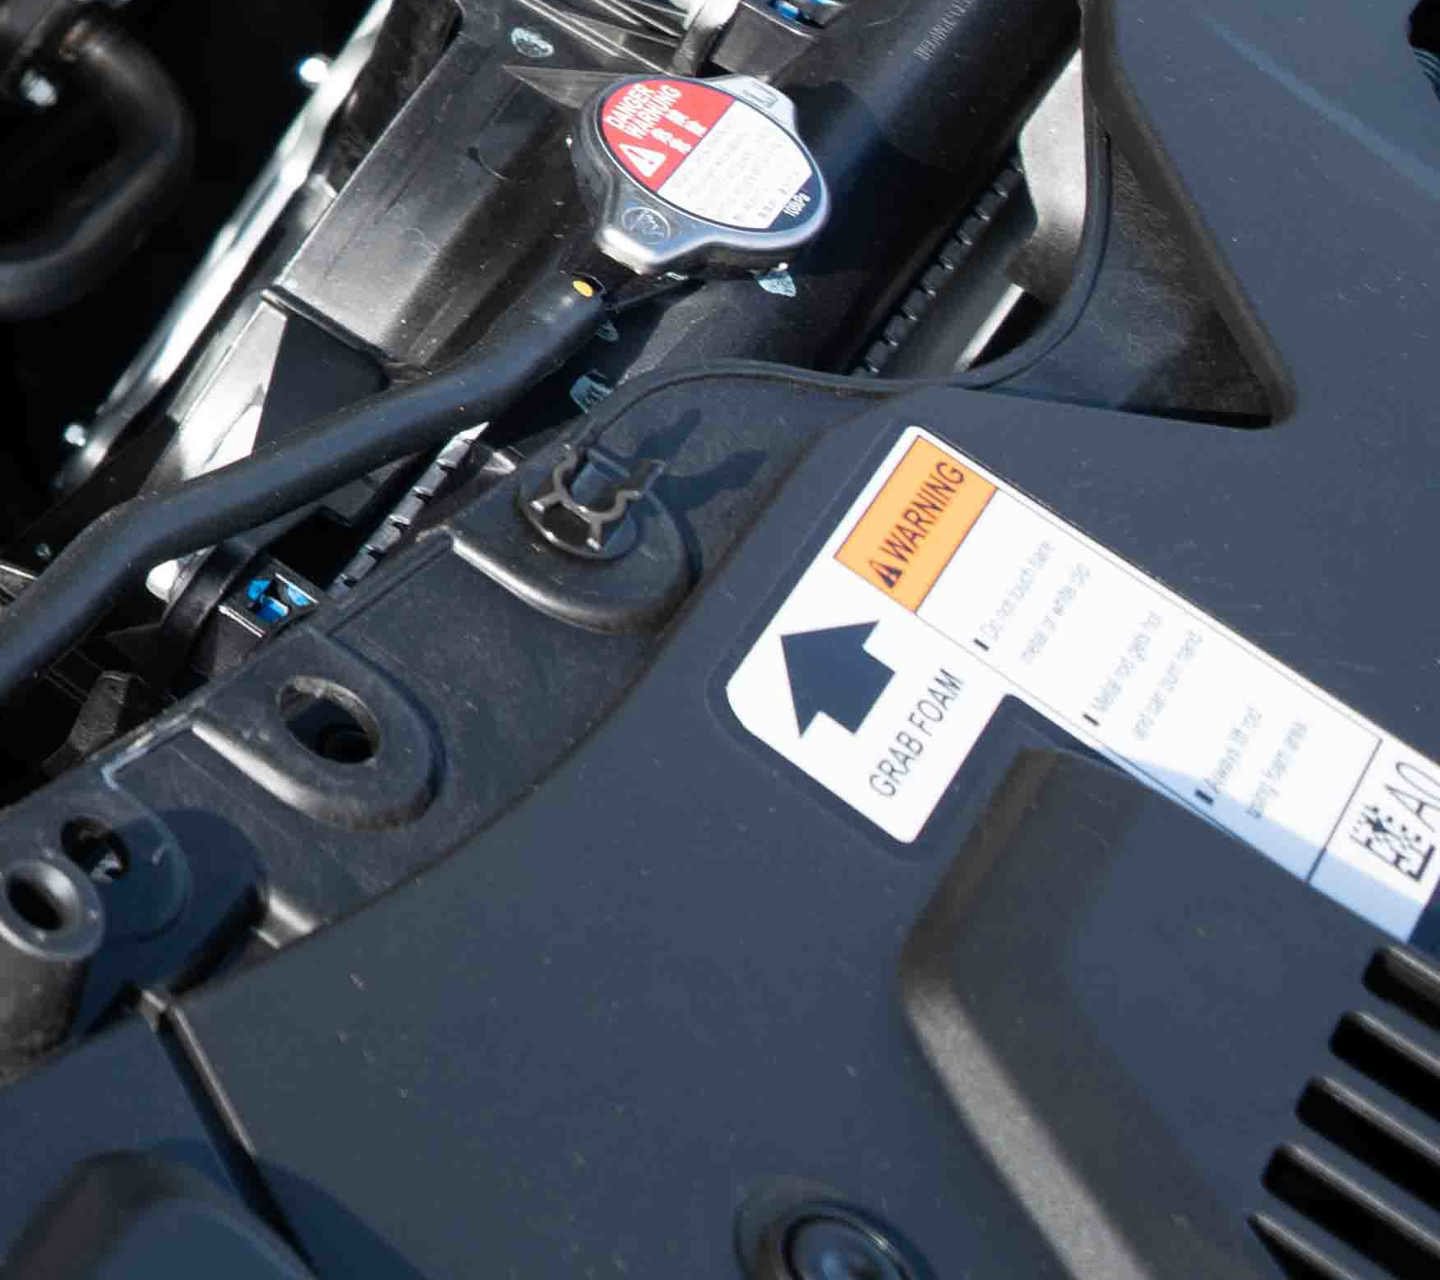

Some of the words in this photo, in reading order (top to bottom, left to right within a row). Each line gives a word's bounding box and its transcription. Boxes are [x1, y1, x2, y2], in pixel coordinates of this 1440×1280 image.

[603, 83, 654, 128] DANGER
[882, 461, 965, 564] WARNING
[869, 730, 924, 798] GRAB
[908, 667, 964, 737] FOAM
